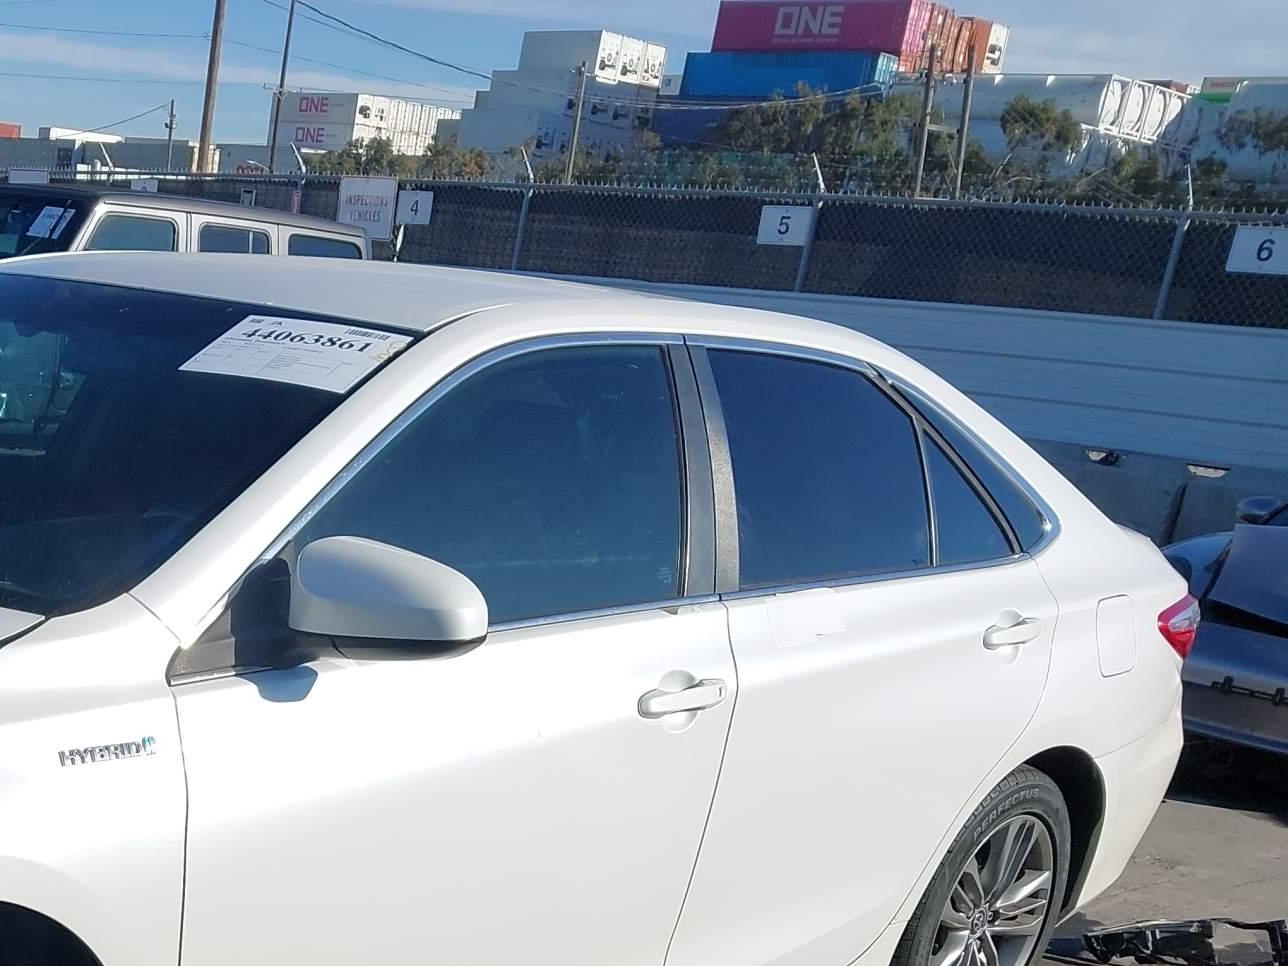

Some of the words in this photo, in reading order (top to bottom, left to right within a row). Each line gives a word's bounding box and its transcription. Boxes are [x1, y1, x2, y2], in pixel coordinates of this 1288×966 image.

[774, 5, 845, 34] ONE
[299, 96, 328, 112] ONE
[295, 127, 325, 143] ONE
[410, 200, 420, 216] 4
[777, 215, 791, 235] 5
[1256, 238, 1276, 262] 6
[242, 328, 374, 352] 44063861
[58, 741, 142, 767] HYBRID
[973, 788, 1041, 840] PERFECTUS
